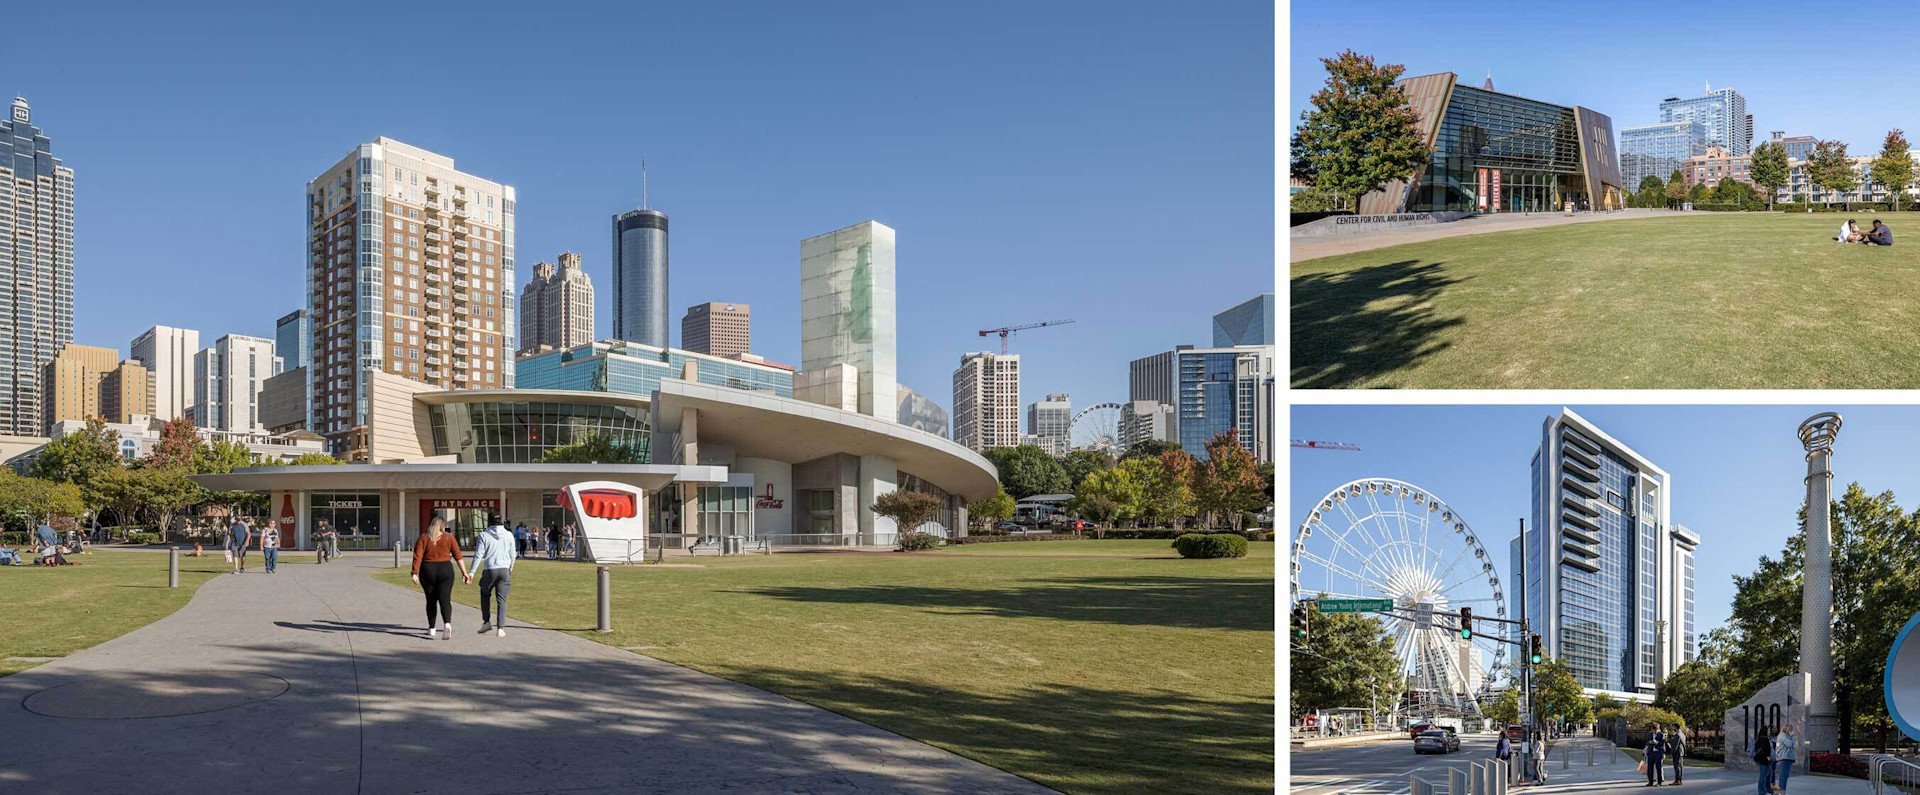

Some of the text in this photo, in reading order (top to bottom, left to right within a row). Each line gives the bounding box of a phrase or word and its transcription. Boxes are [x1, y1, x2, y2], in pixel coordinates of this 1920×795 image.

[1336, 216, 1359, 225] CENTER
[1360, 216, 1371, 224] FOR
[1372, 215, 1386, 223] CIVIL
[1398, 214, 1415, 222] HUMAN
[1416, 213, 1430, 221] RIGHTS
[328, 500, 363, 509] TICKETS
[434, 500, 495, 508] ENTRANCE
[1320, 602, 1338, 610] Andrew
[1339, 602, 1352, 610] Young
[1353, 602, 1382, 610] International
